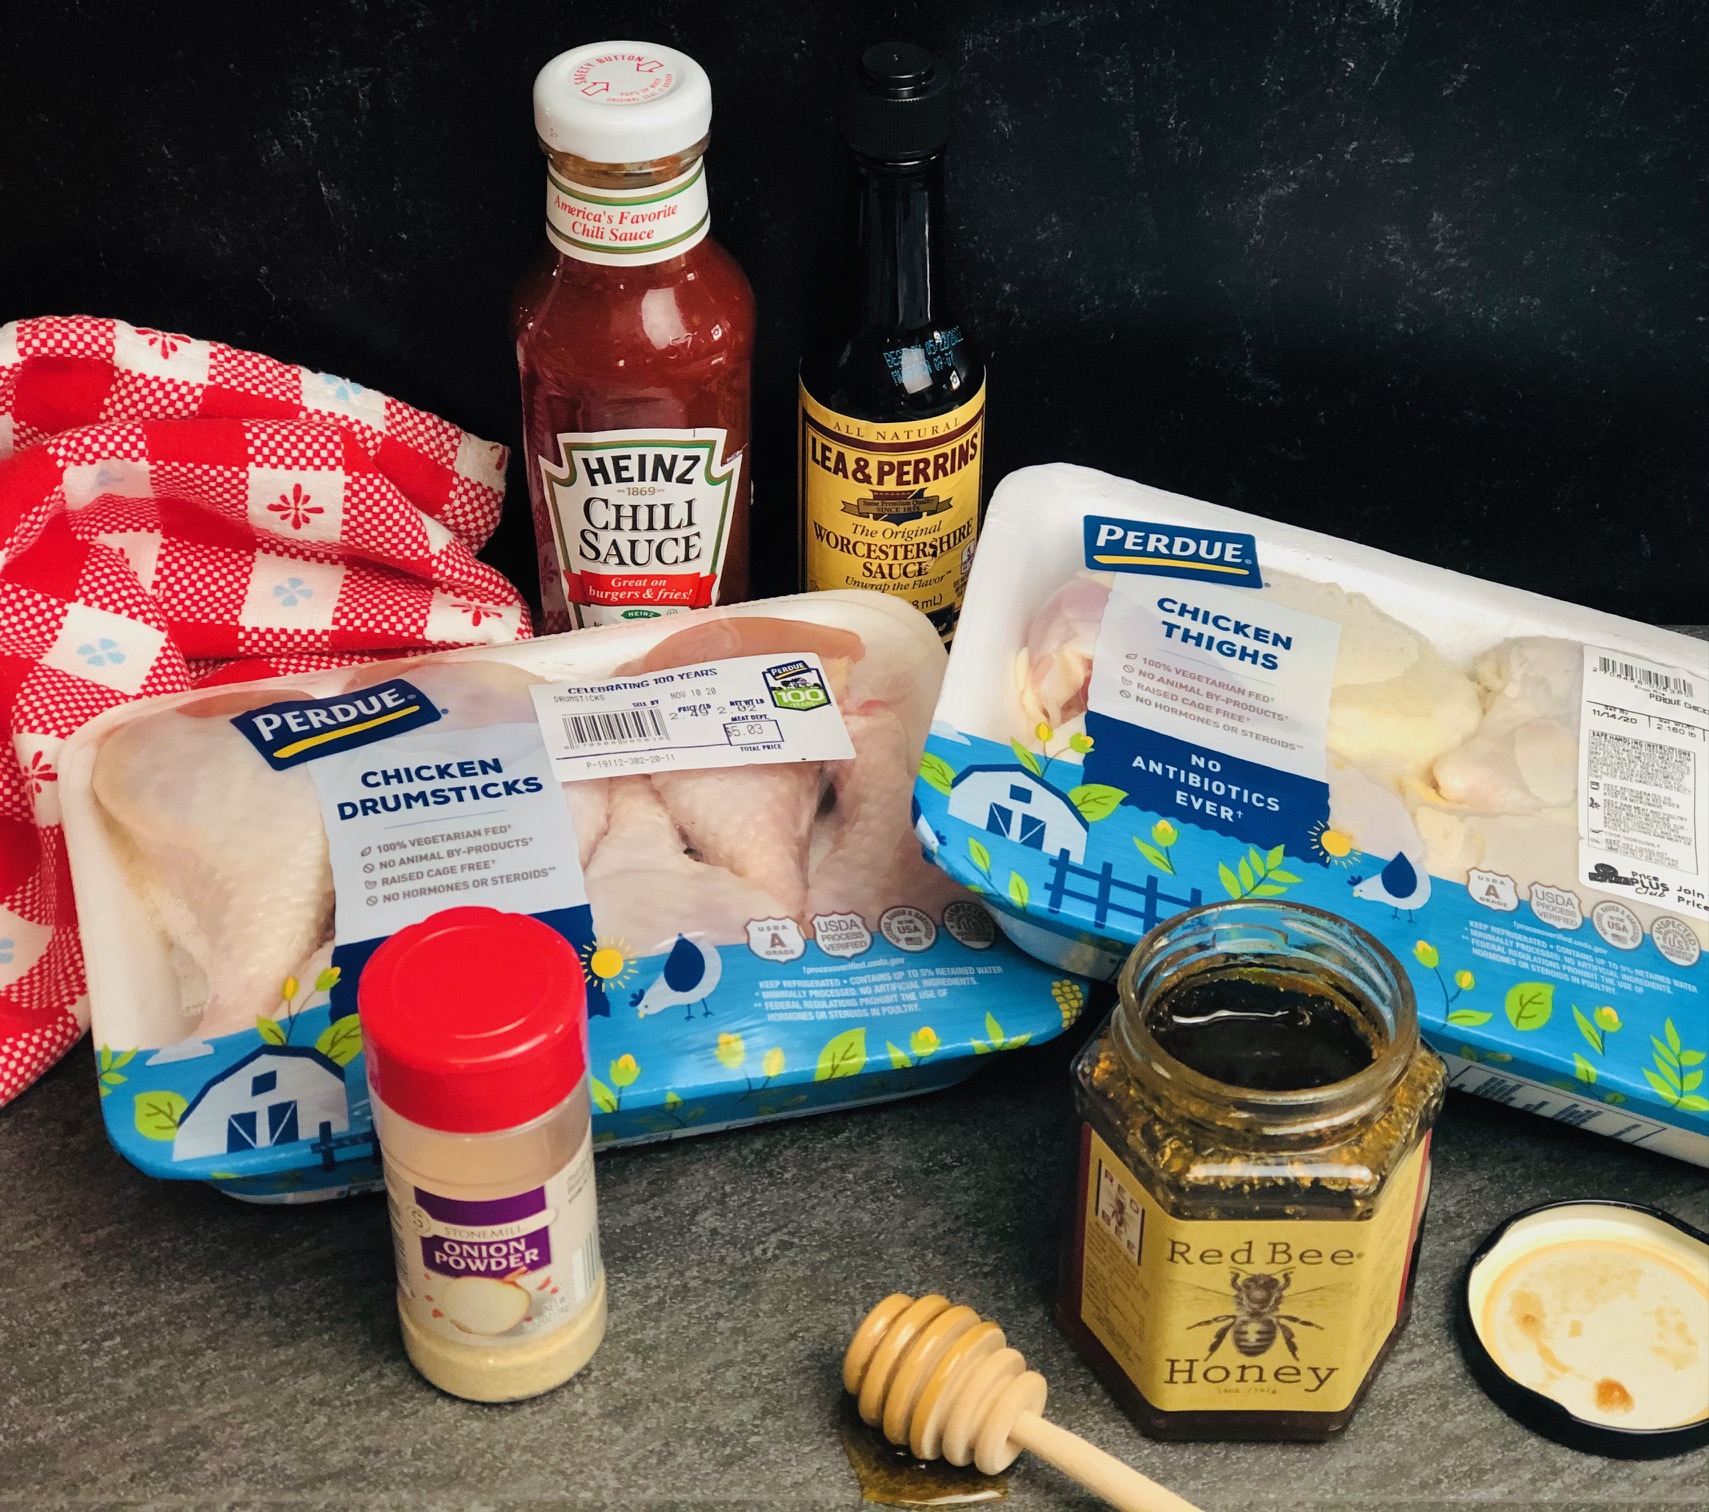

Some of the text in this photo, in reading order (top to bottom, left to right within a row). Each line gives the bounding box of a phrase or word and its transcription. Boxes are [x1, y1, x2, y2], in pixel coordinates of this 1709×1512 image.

[574, 55, 644, 85] SAFETY BUTTON
[554, 195, 678, 225] America's Favorite
[572, 220, 655, 242] Chili Sauce
[833, 417, 961, 440] ALL NATURAL
[581, 454, 702, 487] HEINZ
[626, 487, 656, 496] 1869
[583, 497, 697, 531] CHILI
[812, 517, 974, 562] WORCESTERSHIRE
[852, 520, 942, 542] The Original
[579, 529, 702, 568] SAUCE
[1096, 524, 1244, 564] PERDUE
[862, 562, 928, 580] SAUCE
[611, 577, 667, 588] Great on
[845, 576, 890, 593] Unwrap
[893, 581, 910, 591] the
[588, 586, 693, 602] burgers & fries!
[628, 610, 655, 618] HEINZ
[1157, 597, 1293, 651] CHICKEN
[1161, 620, 1279, 671] THIGHS
[771, 662, 805, 675] PERDUE
[1142, 656, 1172, 673] 100%
[1174, 667, 1246, 696] VEGETARIAN
[568, 668, 718, 694] CELEBRATING 100 YEARS
[1138, 669, 1155, 680] NO
[1157, 676, 1203, 696] ANIMAL
[553, 694, 605, 703] DRUMSTICKS
[670, 687, 716, 700] NOV 10 20
[777, 689, 826, 703] 100
[1136, 682, 1179, 702] RAISED
[1181, 697, 1214, 714] CAGE
[251, 686, 405, 742] PERDUE
[1135, 695, 1152, 706] NO
[1154, 701, 1220, 728] HORMONES
[1222, 723, 1239, 734] OR
[1592, 709, 1638, 724] 11/14/20
[1592, 731, 1691, 757] SAFE HANDLING INSTRUCTIONS
[360, 757, 503, 788] CHICKEN
[1190, 753, 1222, 773] NO
[1131, 755, 1280, 812] ANTIBIOTICS
[336, 776, 543, 821] DRUMSTICKS
[377, 840, 407, 854] 100%
[409, 828, 482, 848] VEGETARIAN
[379, 859, 396, 870] NO
[398, 851, 444, 867] ANIMAL
[381, 871, 424, 887] RAISED
[426, 866, 458, 879] CAGE
[1478, 875, 1506, 886] USDA
[1630, 878, 1669, 891] PLUS
[1631, 871, 1659, 882] Price
[382, 892, 400, 904] NO
[402, 880, 470, 901] HORMONES
[472, 877, 489, 889] OR
[1484, 884, 1500, 899] A
[1535, 889, 1575, 909] USDA
[1677, 886, 1705, 899] Join
[1479, 896, 1508, 908] GRADE
[1536, 901, 1577, 919] PROCESS
[817, 919, 860, 933] USDA
[1538, 910, 1578, 927] VERIFIED
[1608, 921, 1629, 933] USA
[821, 932, 864, 942] PROCESS
[896, 925, 922, 934] USA
[1654, 919, 1696, 945] INSPECTED
[770, 932, 787, 948] A
[824, 940, 867, 952] VERIFIED
[759, 965, 1003, 989] KEEP REFRIGERATED CONTAINS RETAINED WATER
[761, 990, 807, 999] MINIMALLY
[874, 981, 920, 994] ARTIFICIAL
[764, 1000, 803, 1010] FEDERAL
[803, 999, 858, 1009] REGULATIONS
[900, 992, 918, 1001] THE
[919, 990, 936, 999] USE
[937, 988, 948, 997] OF
[766, 1012, 814, 1022] HORMONES
[815, 1011, 828, 1020] OR
[829, 1009, 869, 1019] STEROIDS
[444, 1225, 522, 1240] STONEMILL
[443, 1238, 526, 1258] ONION
[1167, 1238, 1357, 1266] Red Bee
[434, 1248, 540, 1272] POWDER
[1164, 1358, 1339, 1393] Honey
